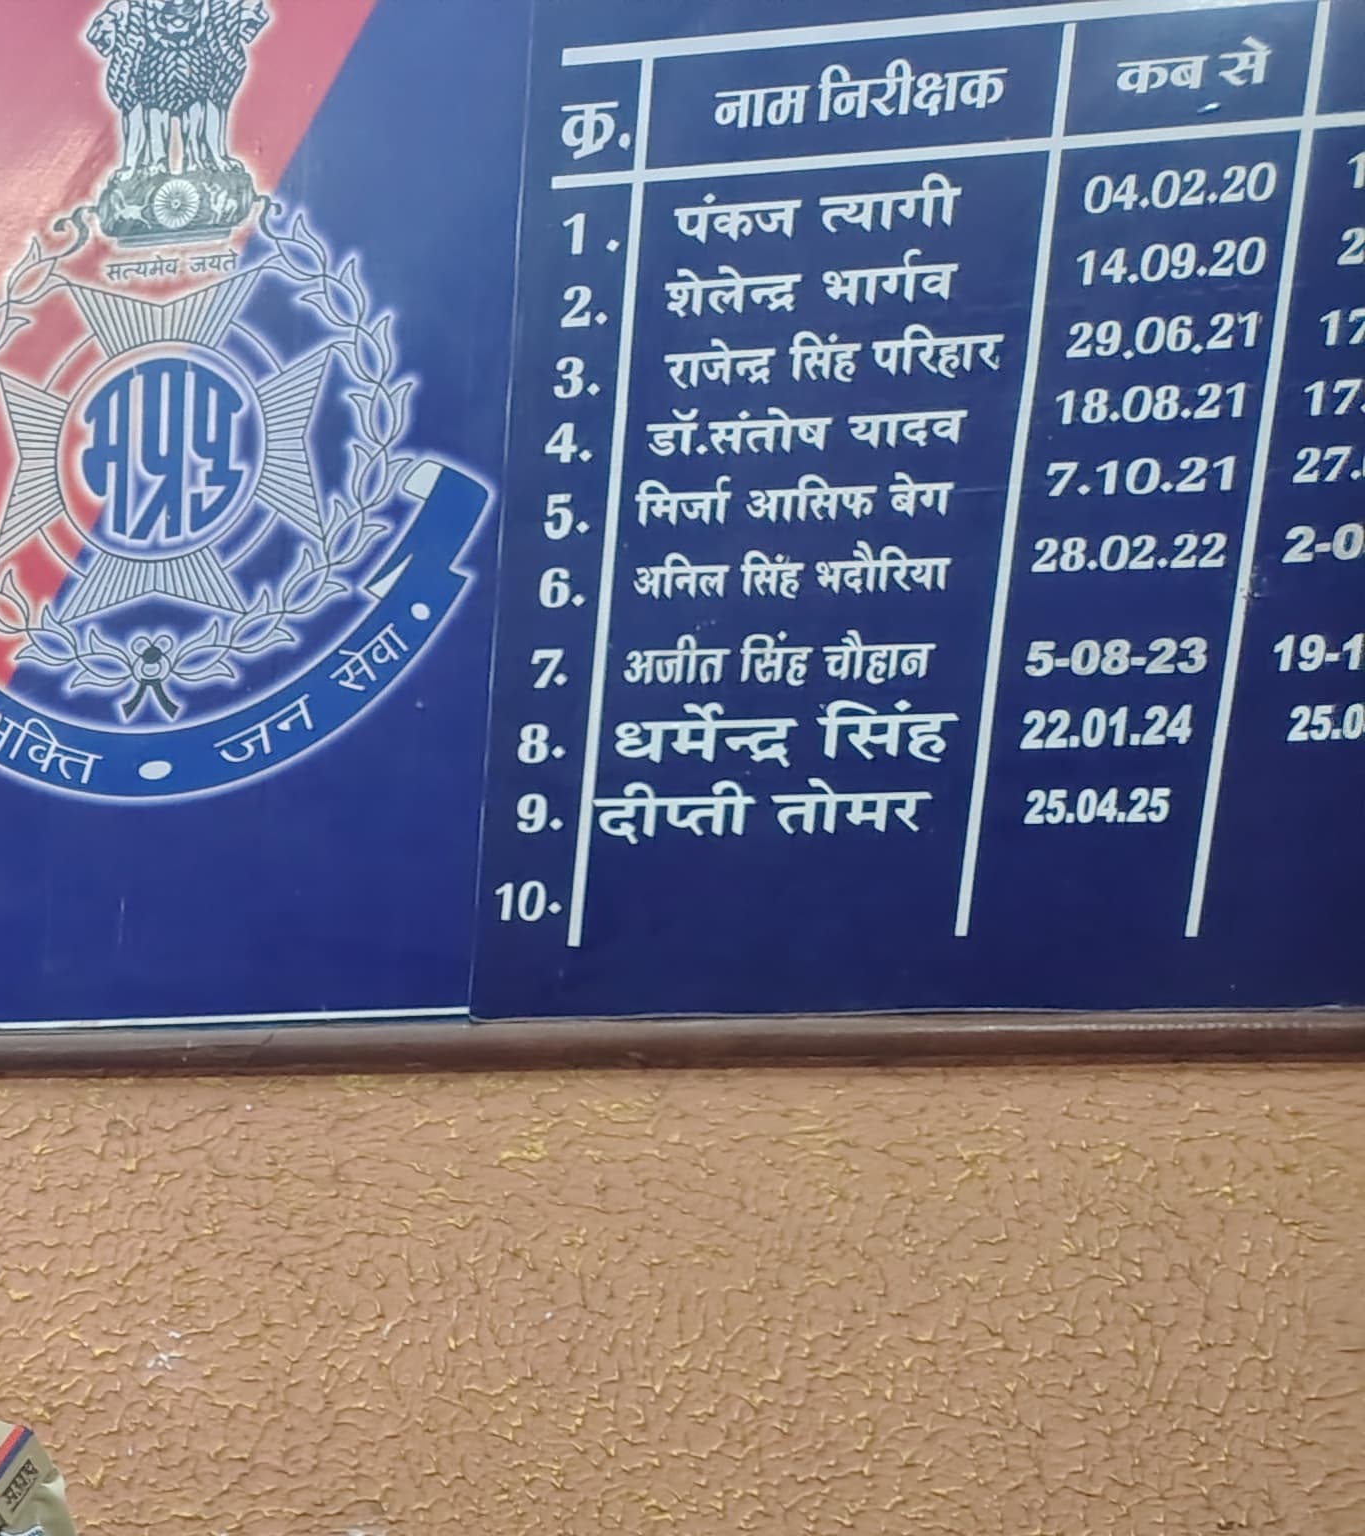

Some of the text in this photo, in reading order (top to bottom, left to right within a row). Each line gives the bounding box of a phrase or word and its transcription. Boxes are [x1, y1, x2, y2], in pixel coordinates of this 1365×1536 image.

[1116, 35, 1272, 94] कब से
[714, 58, 1009, 129] नाम निरीक्षक
[673, 172, 963, 244] पंकज त्यागी
[1084, 161, 1278, 214] 04.02.20
[822, 248, 959, 306] भार्गव
[1076, 236, 1267, 286] 14.09.20
[560, 285, 608, 328] 2.
[788, 330, 862, 383] सिंह
[871, 326, 1005, 379] परिहार
[1065, 311, 1263, 360] 29.06.21
[553, 356, 600, 399] 3.
[1055, 381, 1246, 425] 18.08.21
[544, 422, 593, 464] 4.
[847, 409, 968, 449] यादव
[634, 471, 955, 527] मिर्जा आसिफ बेग
[1046, 455, 1236, 497] 7.10.21
[543, 493, 590, 540] 5.
[633, 552, 731, 599] अनिल
[740, 549, 805, 599] सिंह
[1031, 532, 1228, 573] 28.02.22
[539, 567, 585, 609] 6.
[531, 648, 568, 689] 7.
[623, 629, 937, 687] अजीत सिंह चौहान
[1024, 636, 1208, 677] 5-08-23
[214, 621, 411, 763] जन सेवा
[517, 723, 566, 764] 8.
[816, 699, 960, 763] सिंह
[1019, 704, 1193, 750] 22.01.24
[516, 793, 563, 834] 9.
[591, 775, 933, 845] दीप्ती तोमर
[1023, 787, 1172, 825] 25.04.25
[495, 880, 562, 922] 10.
